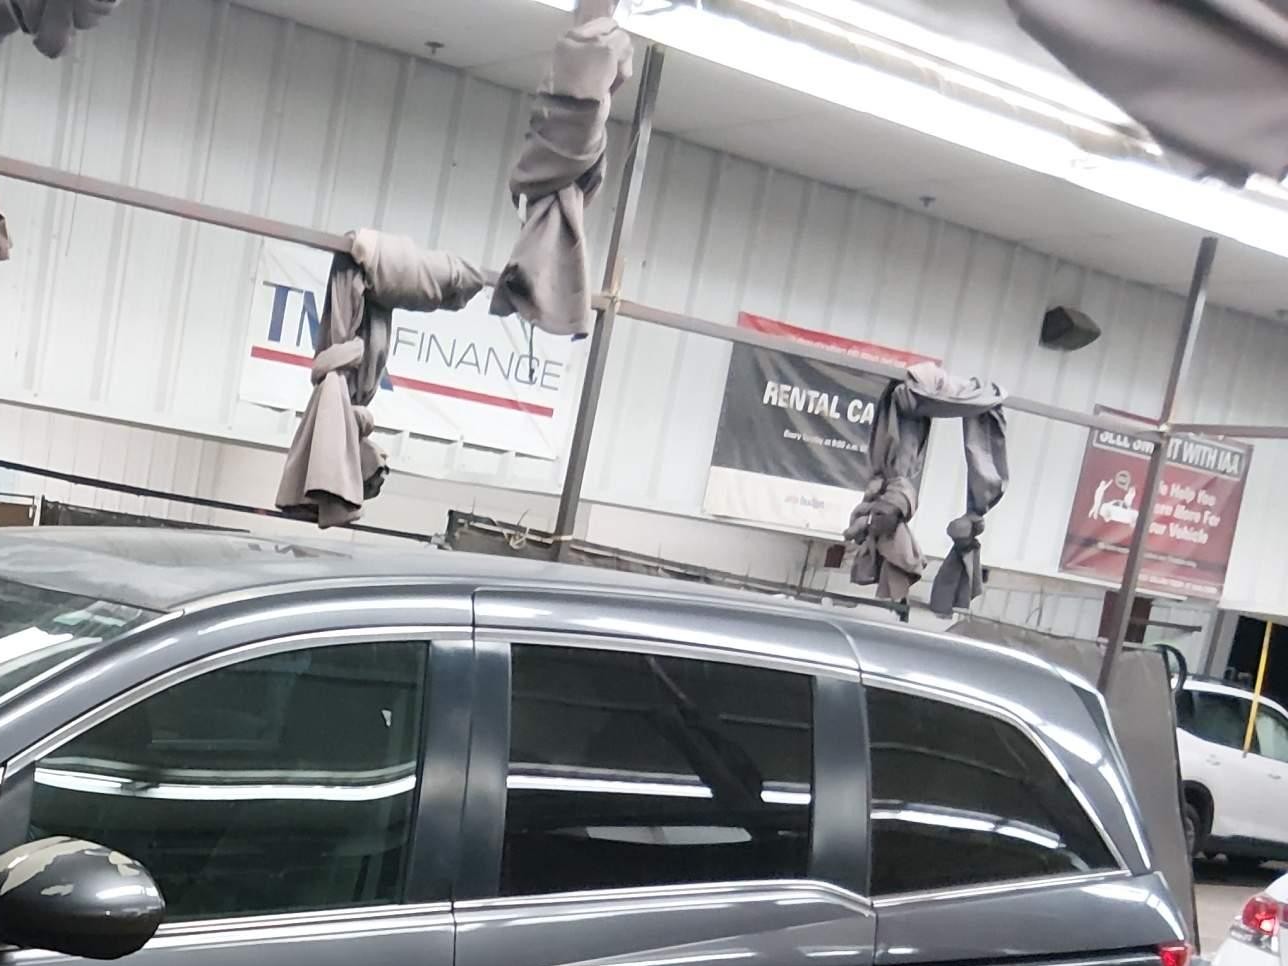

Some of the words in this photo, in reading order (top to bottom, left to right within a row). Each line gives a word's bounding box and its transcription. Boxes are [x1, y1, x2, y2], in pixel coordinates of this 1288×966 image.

[392, 326, 564, 391] FINANCE
[763, 380, 841, 419] RENTAL
[1182, 441, 1218, 470] WITH
[1218, 452, 1241, 475] IAA
